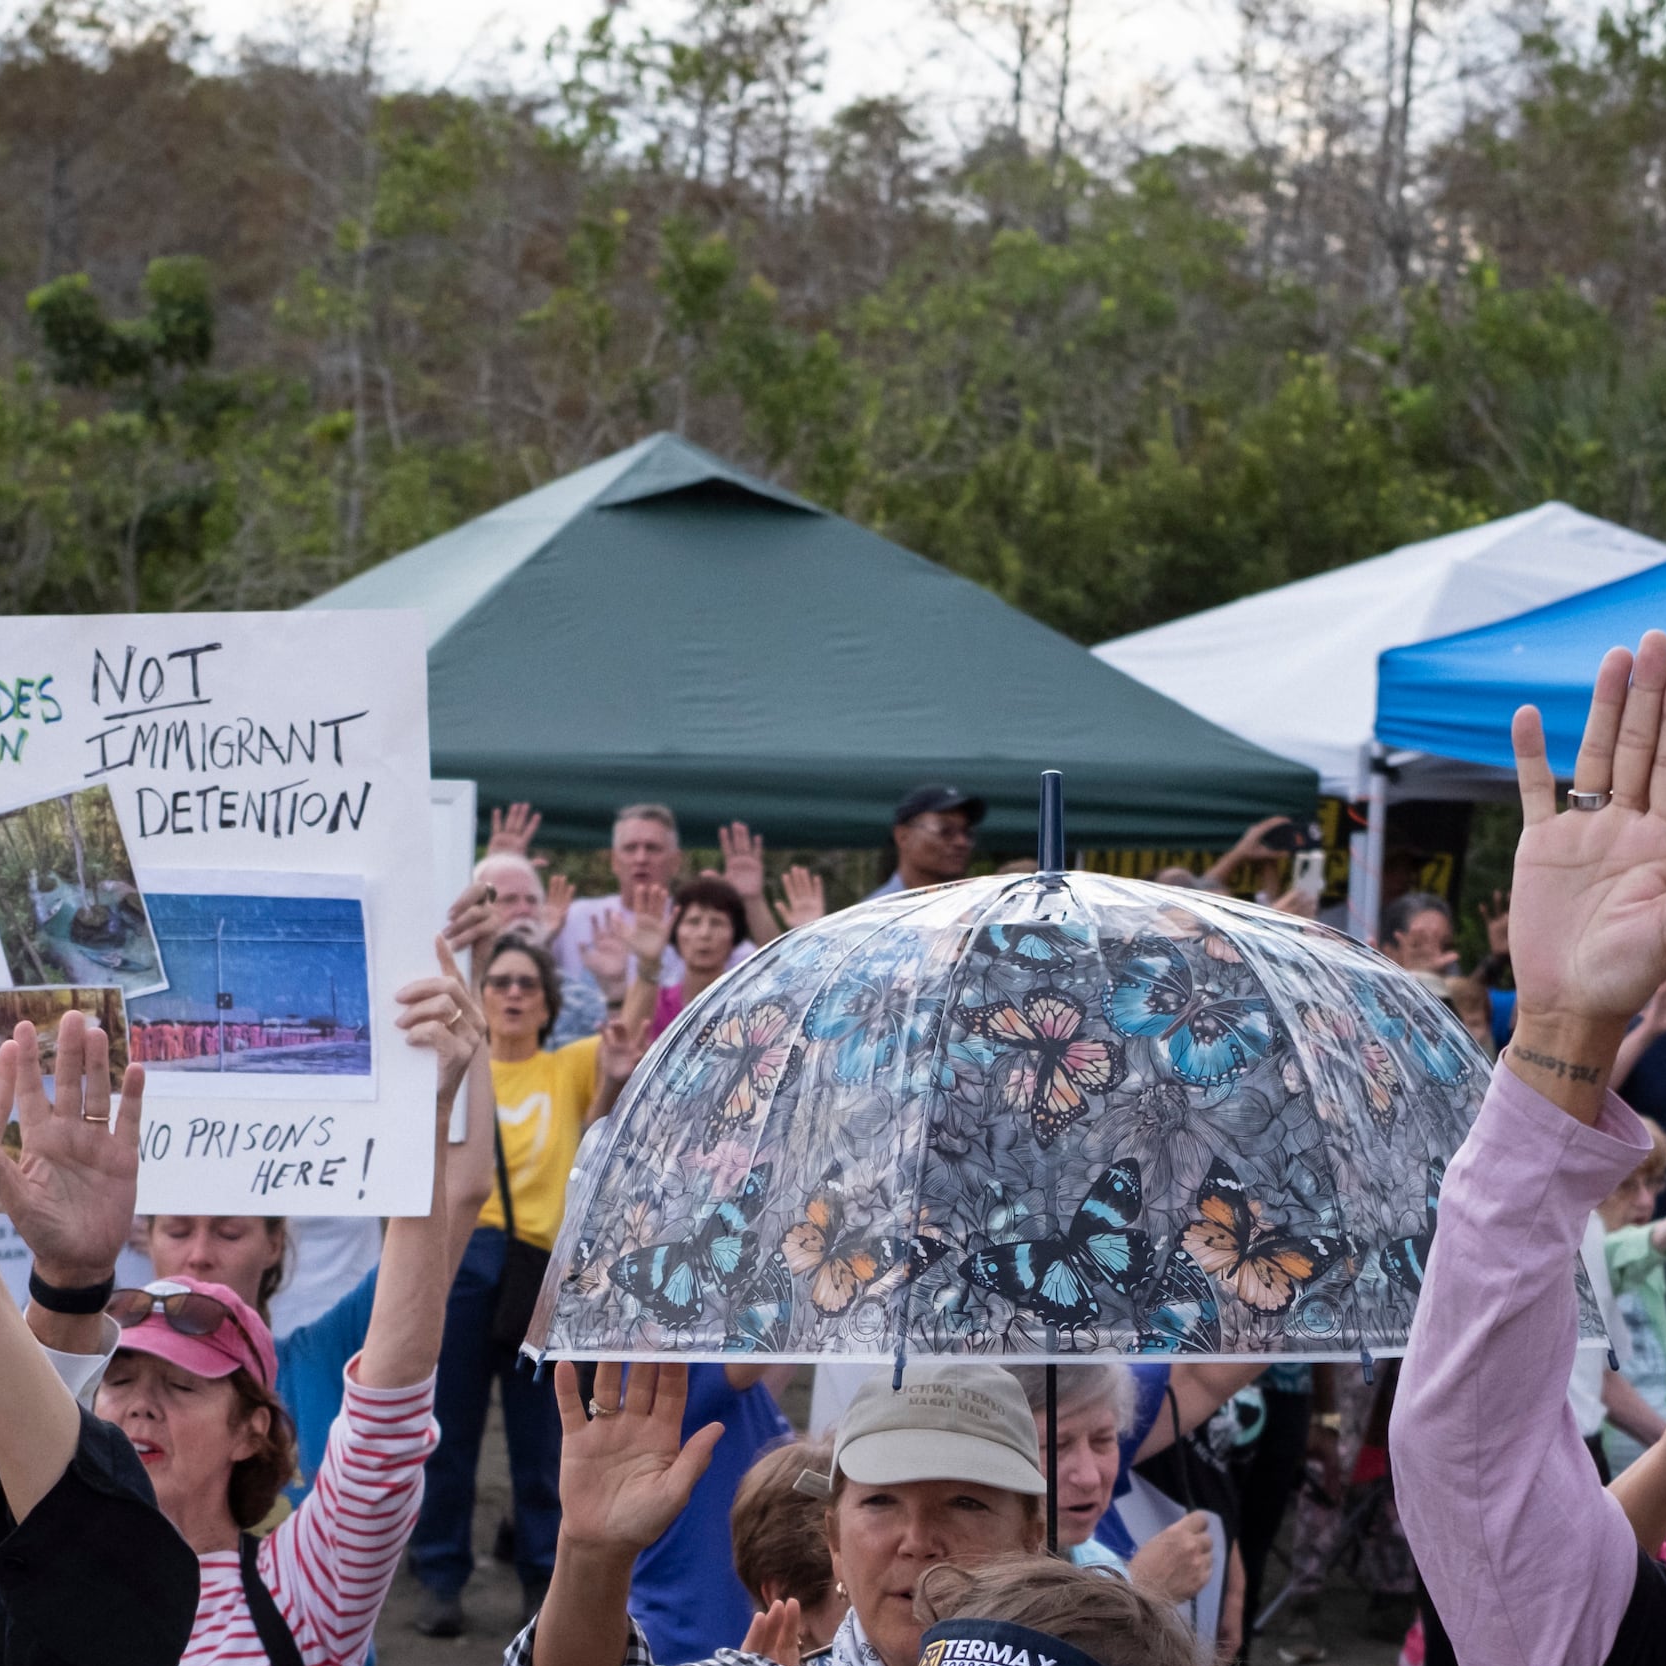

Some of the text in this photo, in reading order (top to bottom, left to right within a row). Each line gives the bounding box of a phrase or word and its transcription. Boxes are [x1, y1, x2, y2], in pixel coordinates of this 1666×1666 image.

[91, 642, 223, 706] NOT
[83, 710, 370, 778] IMMIGRANT
[136, 779, 372, 840] DETENTION
[185, 1115, 335, 1158] PRISONS
